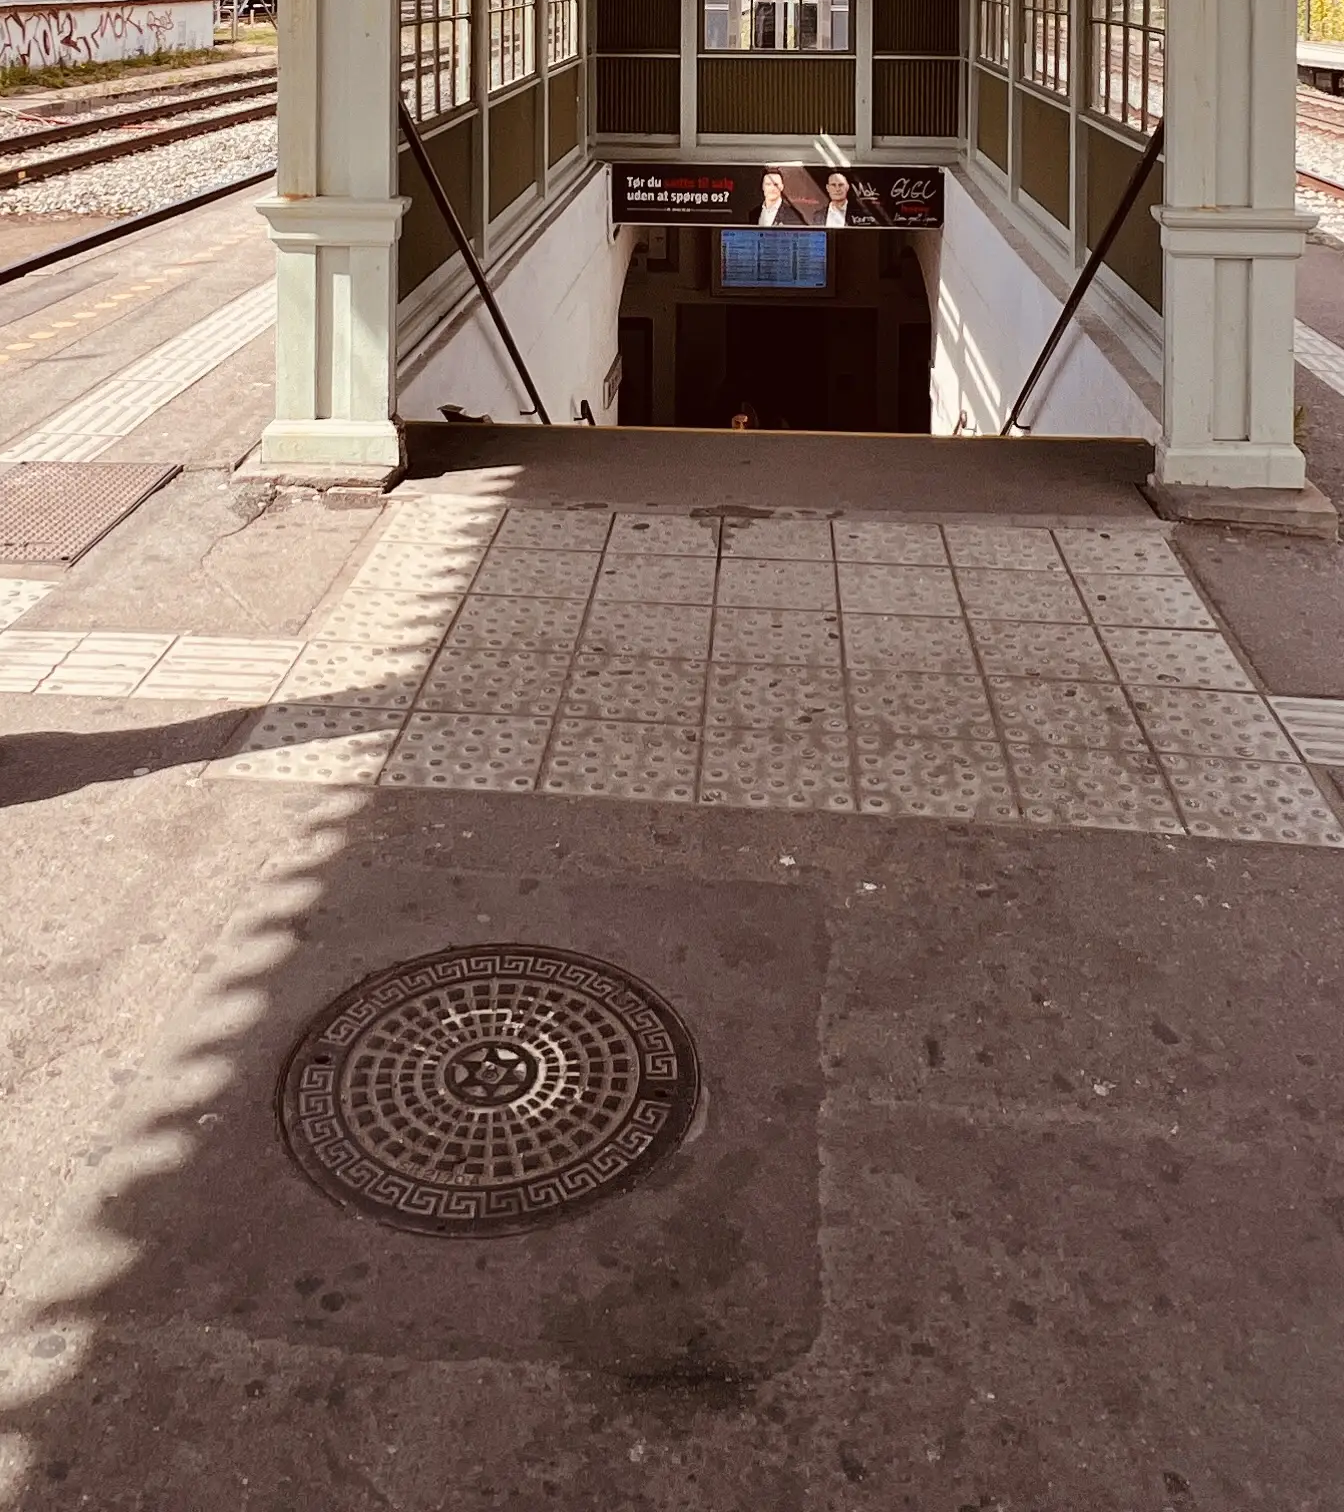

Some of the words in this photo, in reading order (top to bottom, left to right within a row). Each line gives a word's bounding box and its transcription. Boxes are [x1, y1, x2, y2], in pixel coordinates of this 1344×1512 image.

[626, 176, 645, 189] Tør
[647, 175, 662, 188] du
[626, 189, 655, 202] uden
[656, 190, 669, 202] at
[670, 191, 709, 205] spørge
[710, 190, 730, 203] os?
